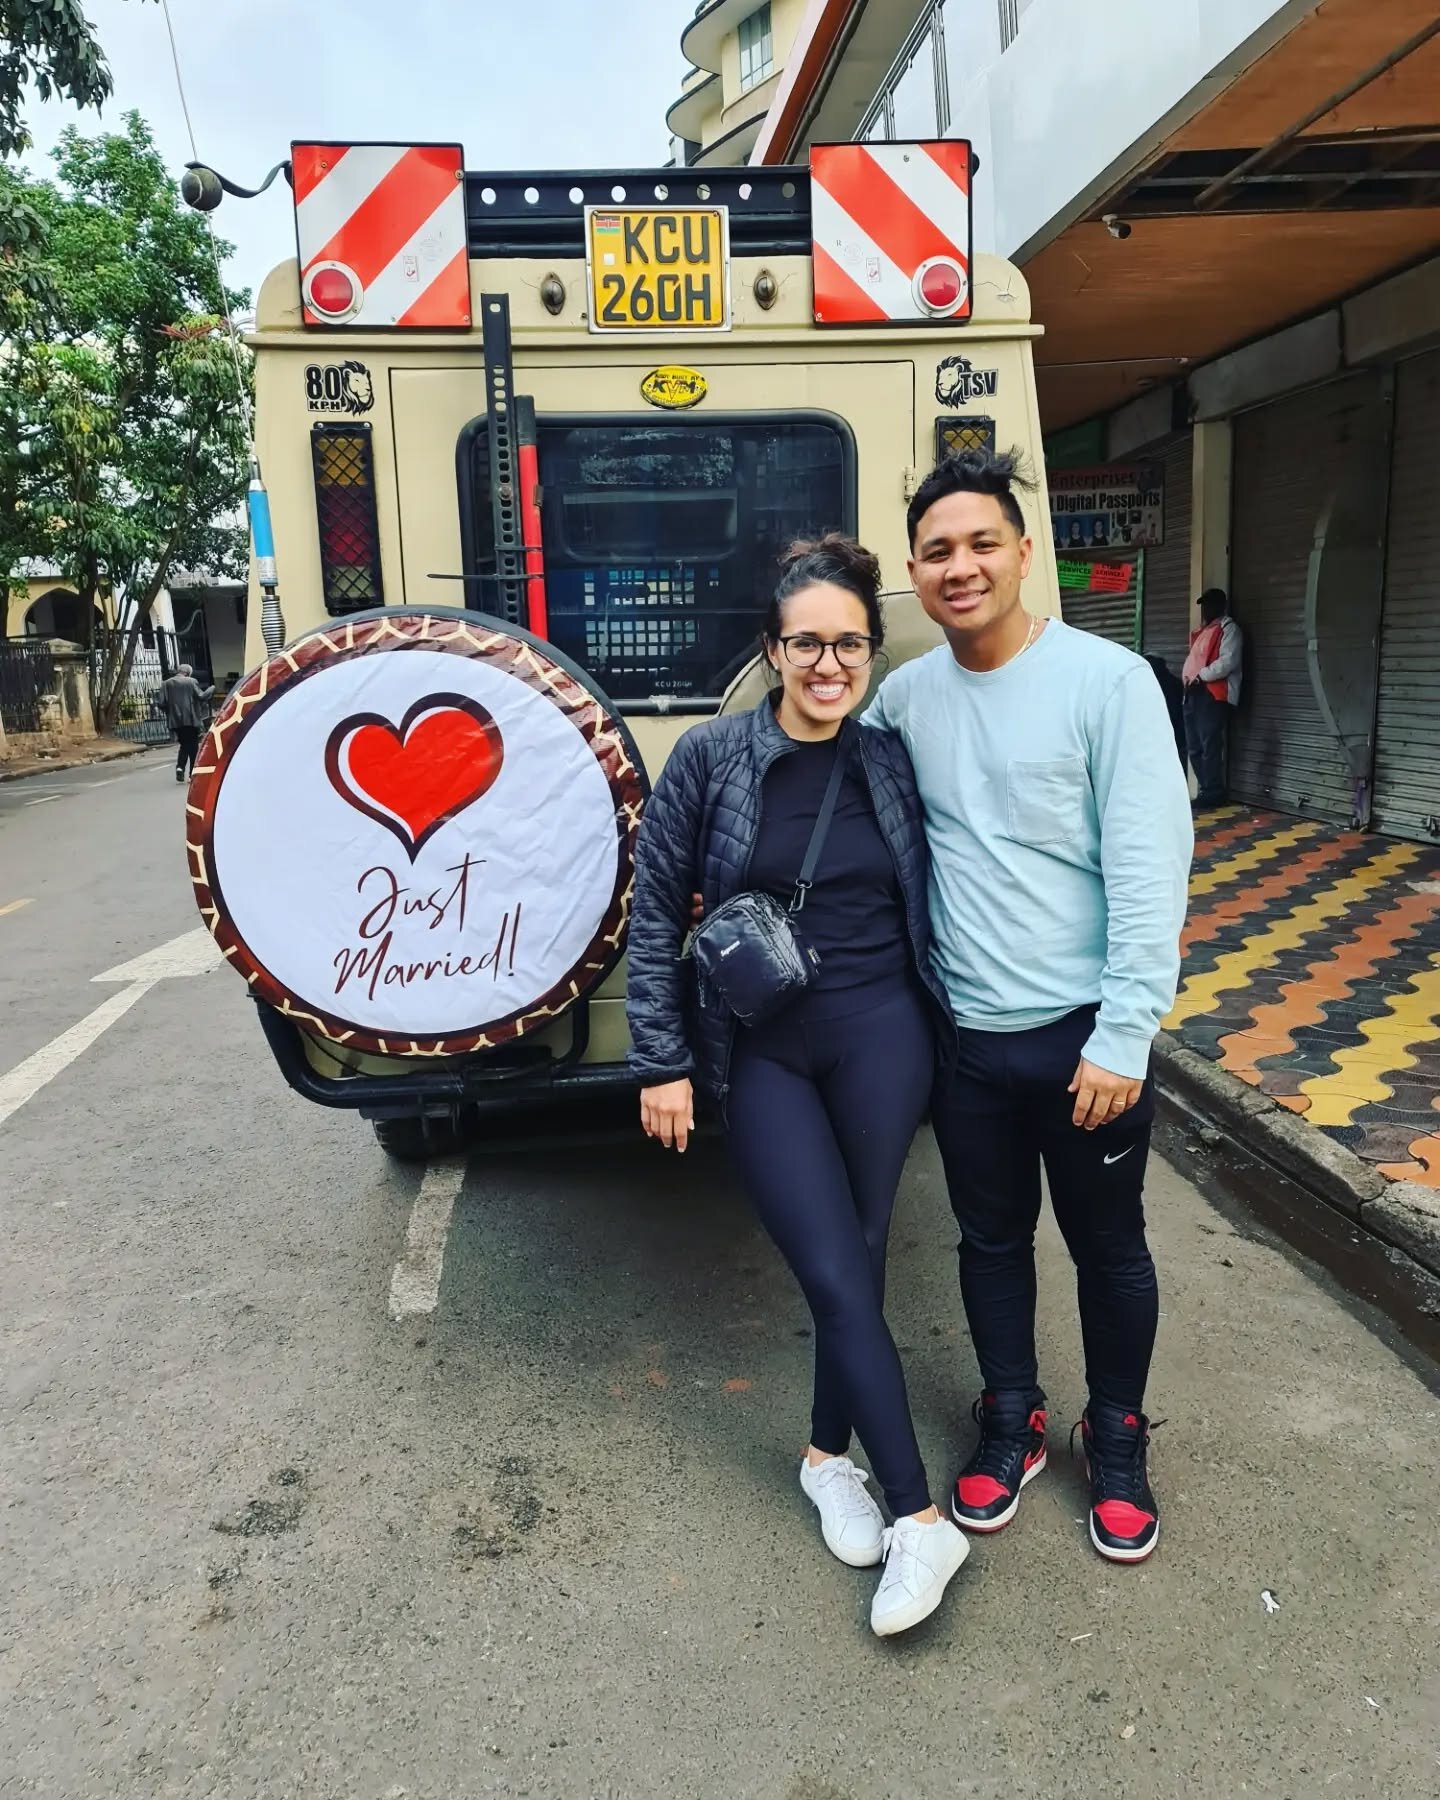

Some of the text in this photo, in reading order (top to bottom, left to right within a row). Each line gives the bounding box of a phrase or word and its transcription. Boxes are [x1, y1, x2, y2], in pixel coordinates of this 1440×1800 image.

[623, 215, 710, 264] KCU
[602, 273, 712, 321] 260H
[305, 366, 342, 400] 80
[960, 371, 997, 397] TSV
[309, 400, 341, 410] KPH
[1049, 471, 1137, 490] Enterprises
[1056, 494, 1097, 512] Digital
[1099, 492, 1161, 509] Passports
[358, 852, 487, 939] Just
[333, 902, 522, 1001] Married!
